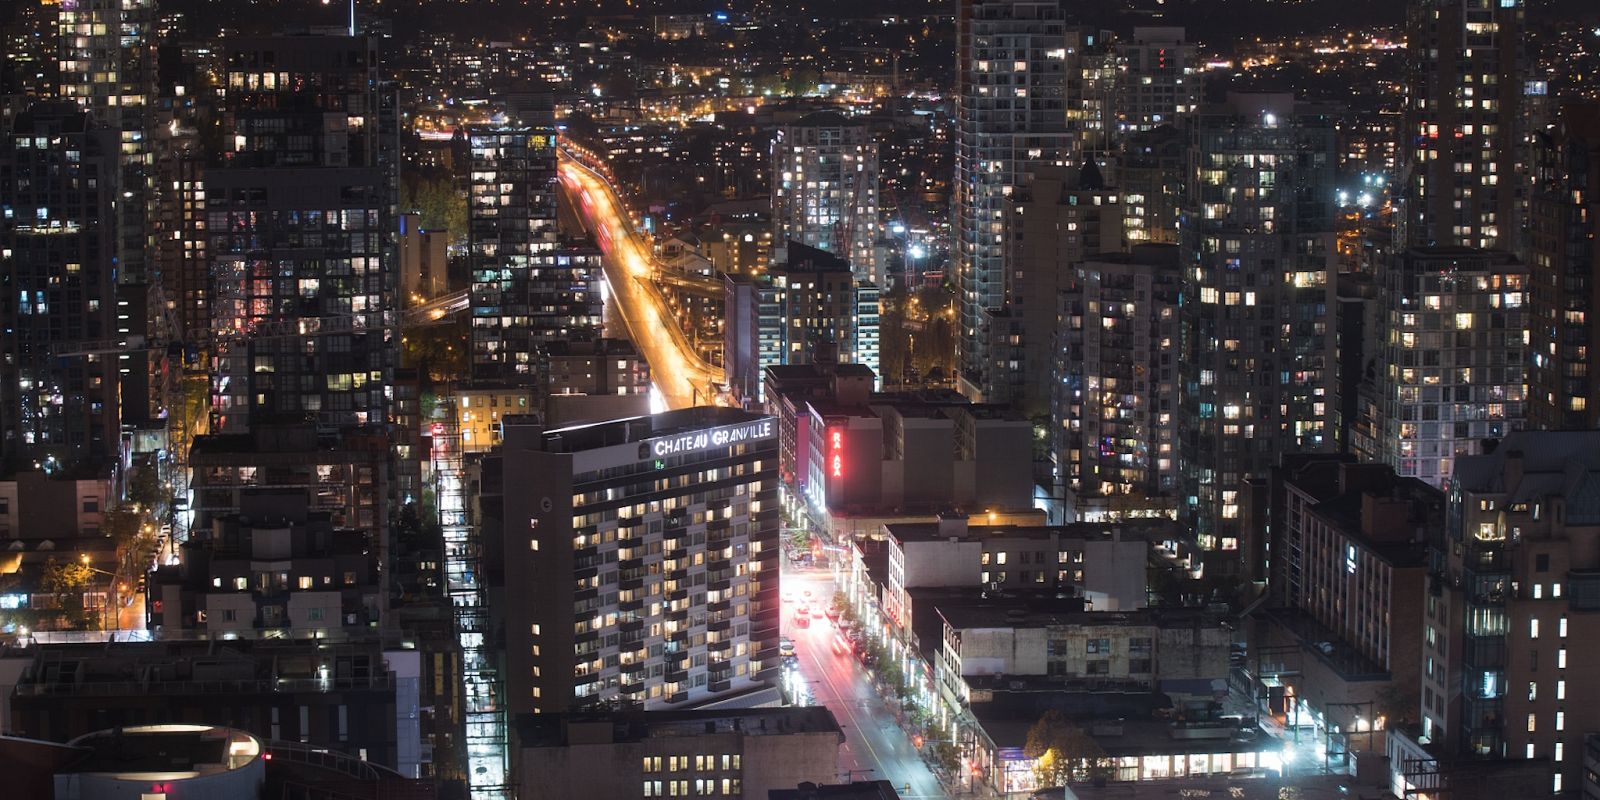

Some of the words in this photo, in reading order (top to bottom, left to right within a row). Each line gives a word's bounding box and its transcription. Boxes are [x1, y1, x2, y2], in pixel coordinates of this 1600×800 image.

[655, 434, 708, 456] CHATEAU
[712, 422, 771, 446] GRANVILLE
[833, 431, 841, 477] RAADA
